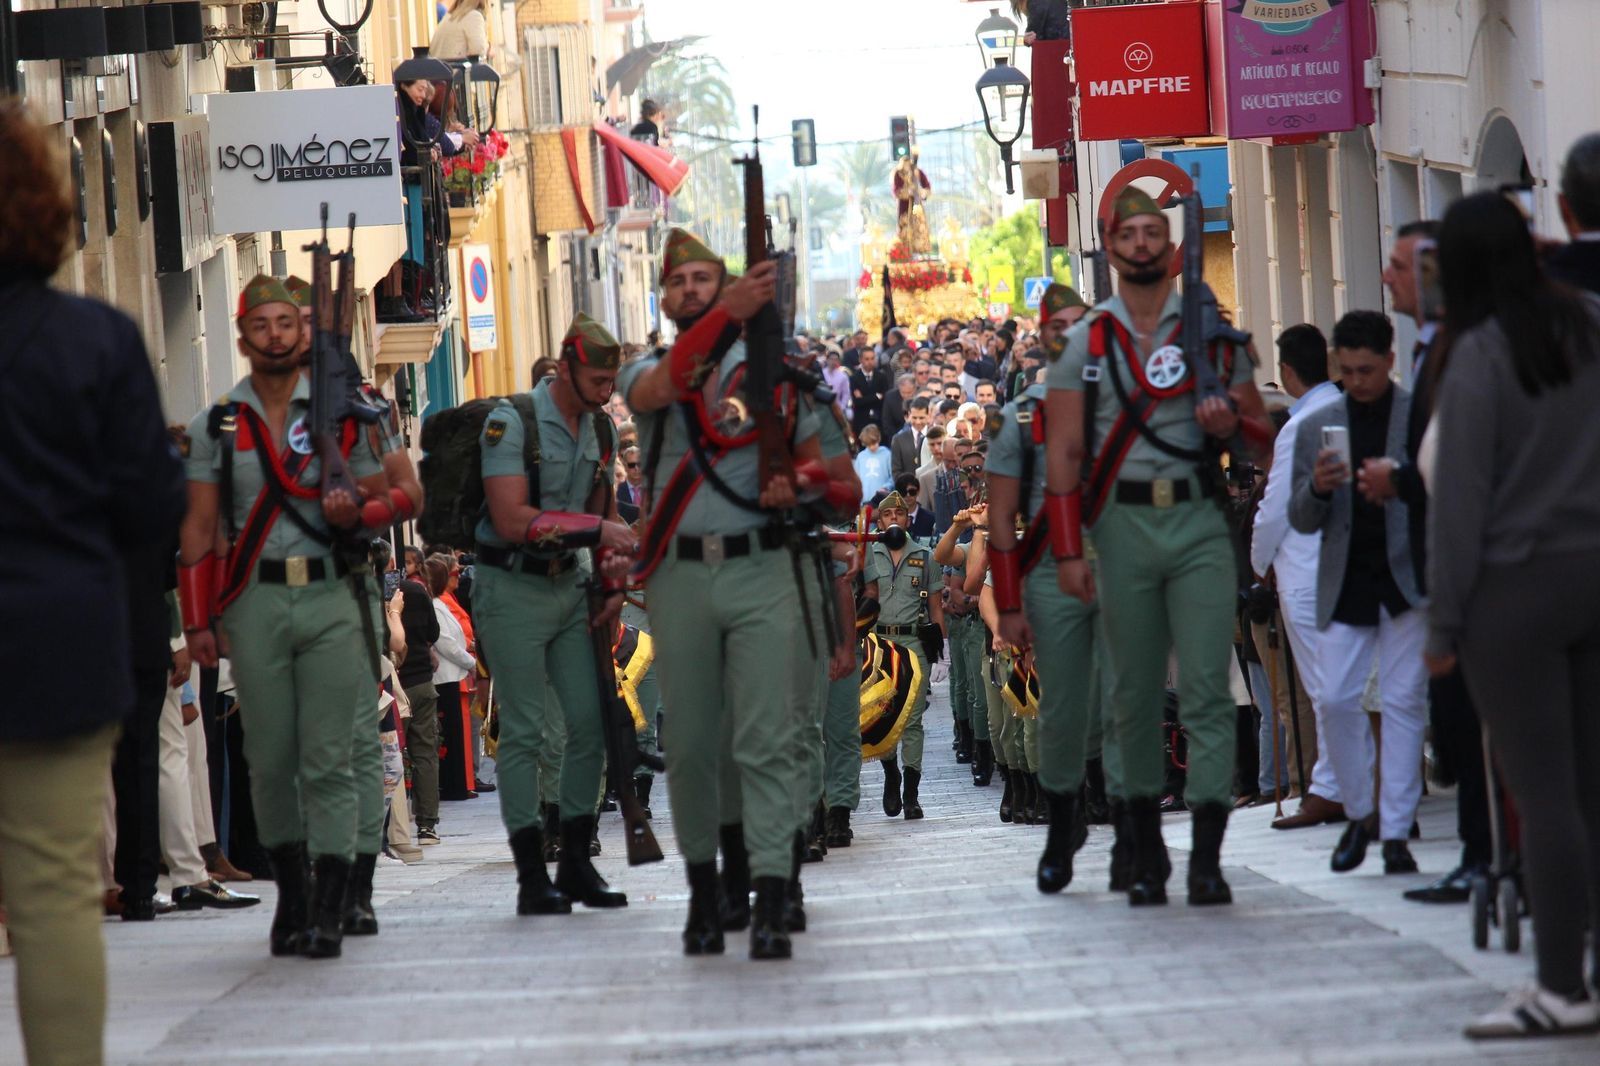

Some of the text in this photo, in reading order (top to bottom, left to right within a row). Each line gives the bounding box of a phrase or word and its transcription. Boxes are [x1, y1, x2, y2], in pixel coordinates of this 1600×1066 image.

[1254, 2, 1318, 19] VARIEDADES
[1240, 60, 1340, 80] ARTÍCULOS DE REGALO
[1089, 76, 1191, 97] MAPFRE
[1241, 88, 1342, 110] MULTIPRECIO
[283, 165, 386, 179] PELUQUERÍA
